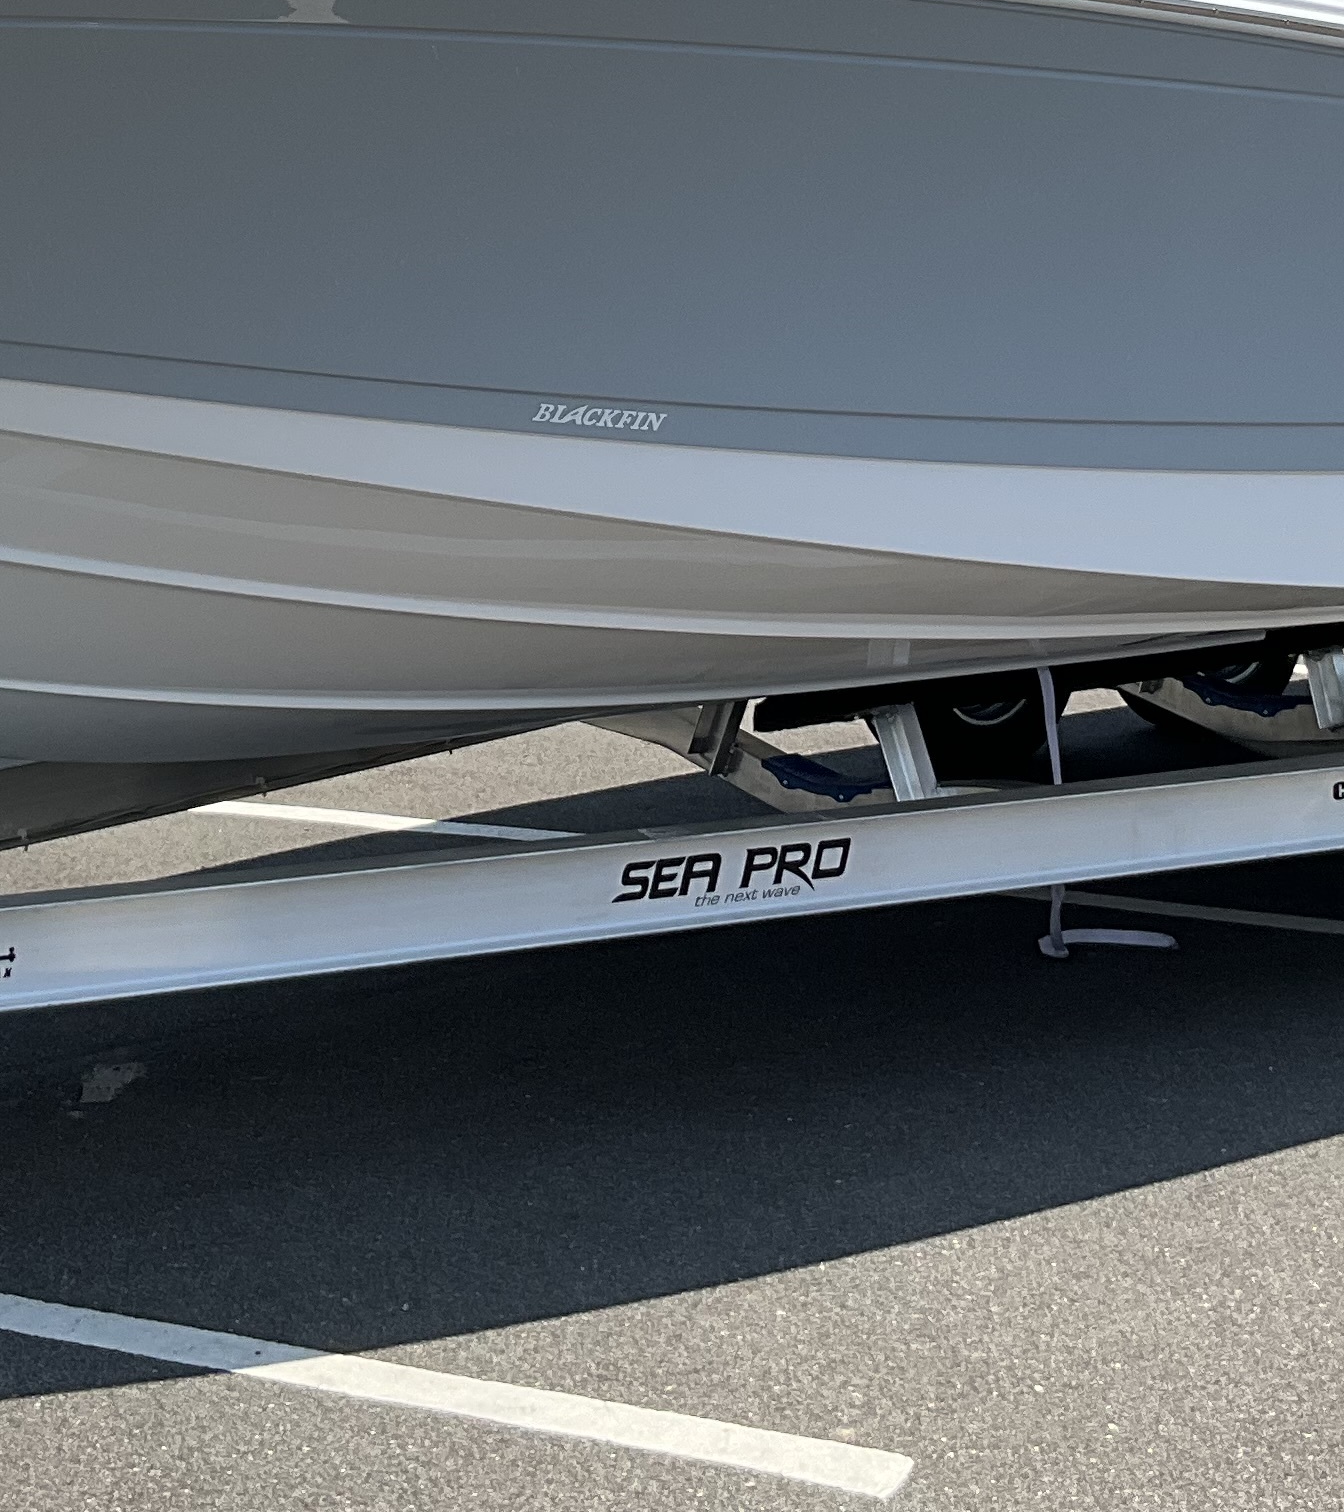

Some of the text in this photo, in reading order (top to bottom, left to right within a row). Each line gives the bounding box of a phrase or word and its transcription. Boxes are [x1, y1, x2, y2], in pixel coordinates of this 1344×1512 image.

[532, 403, 668, 432] BLACKFIN
[611, 836, 852, 904] SEA PRO
[694, 885, 801, 908] the next wave
